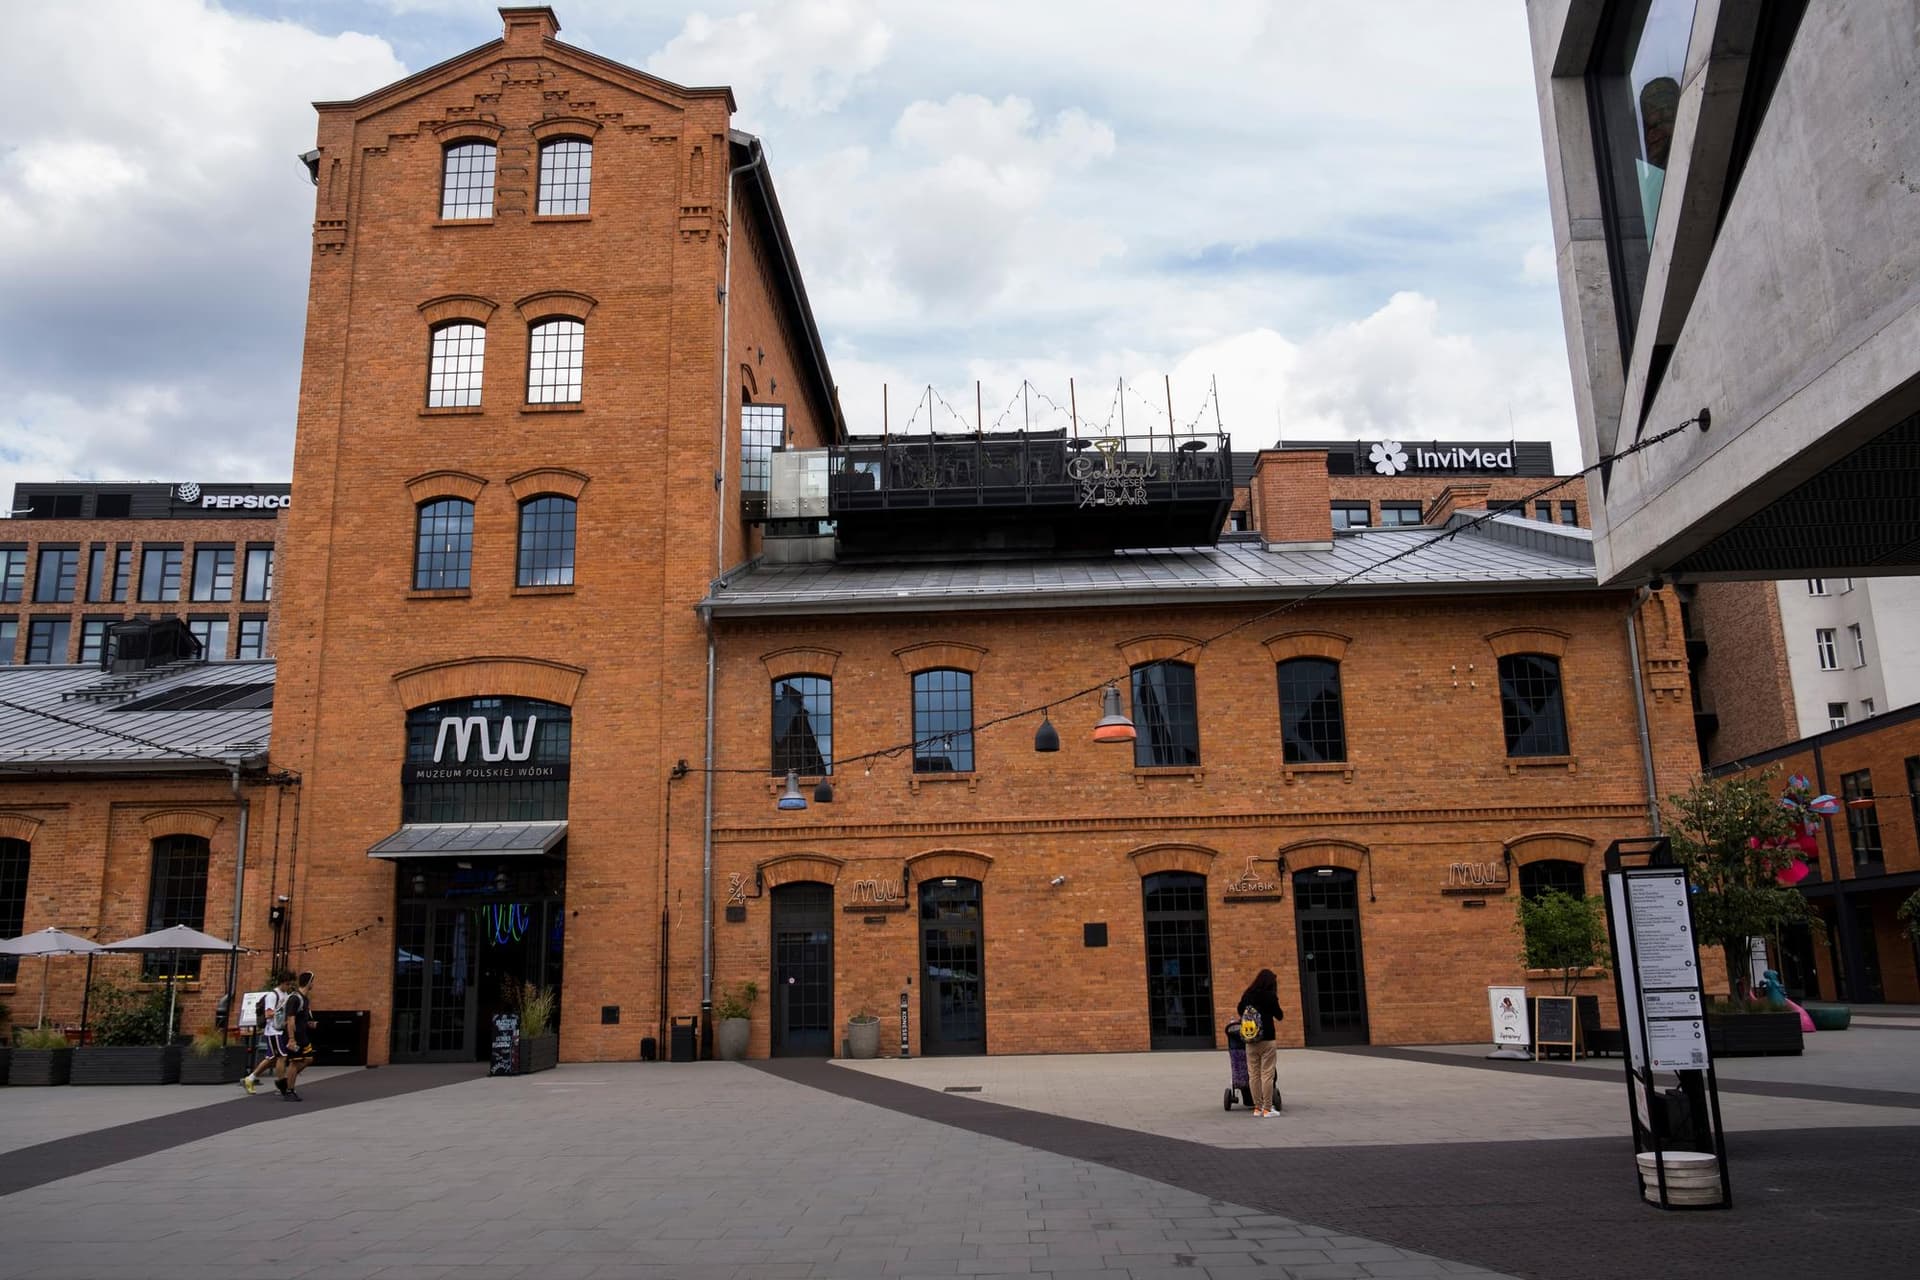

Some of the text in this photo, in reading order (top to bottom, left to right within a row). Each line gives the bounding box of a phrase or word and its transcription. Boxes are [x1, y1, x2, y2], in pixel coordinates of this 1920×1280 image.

[1416, 447, 1513, 469] InviMed
[1104, 479, 1146, 488] KONESER
[201, 495, 291, 509] PEPSICO
[1104, 487, 1149, 506] BAR
[416, 766, 553, 778] MUZEUM POLSKIEJ WÓDKI
[1229, 881, 1274, 892] ALEMBIK
